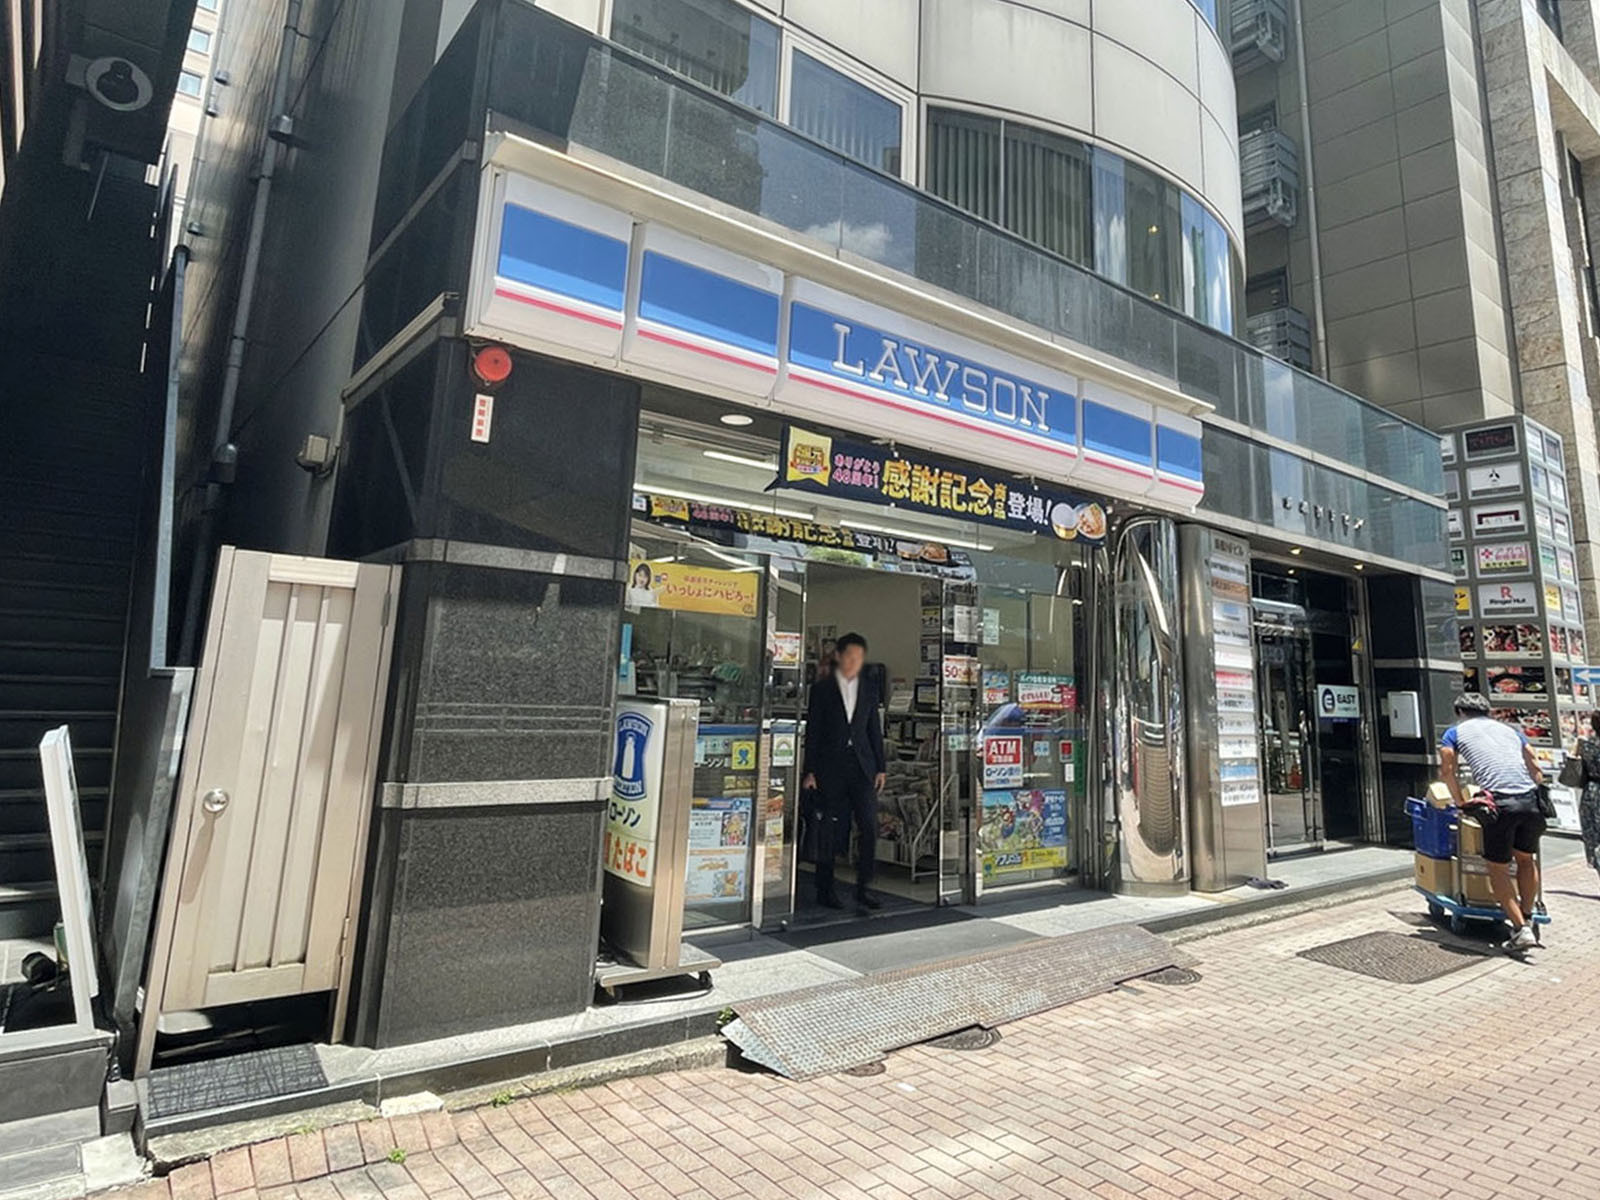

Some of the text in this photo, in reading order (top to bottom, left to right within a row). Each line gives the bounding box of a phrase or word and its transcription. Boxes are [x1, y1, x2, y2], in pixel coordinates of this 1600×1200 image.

[832, 323, 1049, 432] LAWSON
[881, 459, 993, 516] 感謝記念
[1500, 586, 1513, 599] R
[1337, 694, 1356, 704] EAST
[989, 741, 1017, 754] ATM
